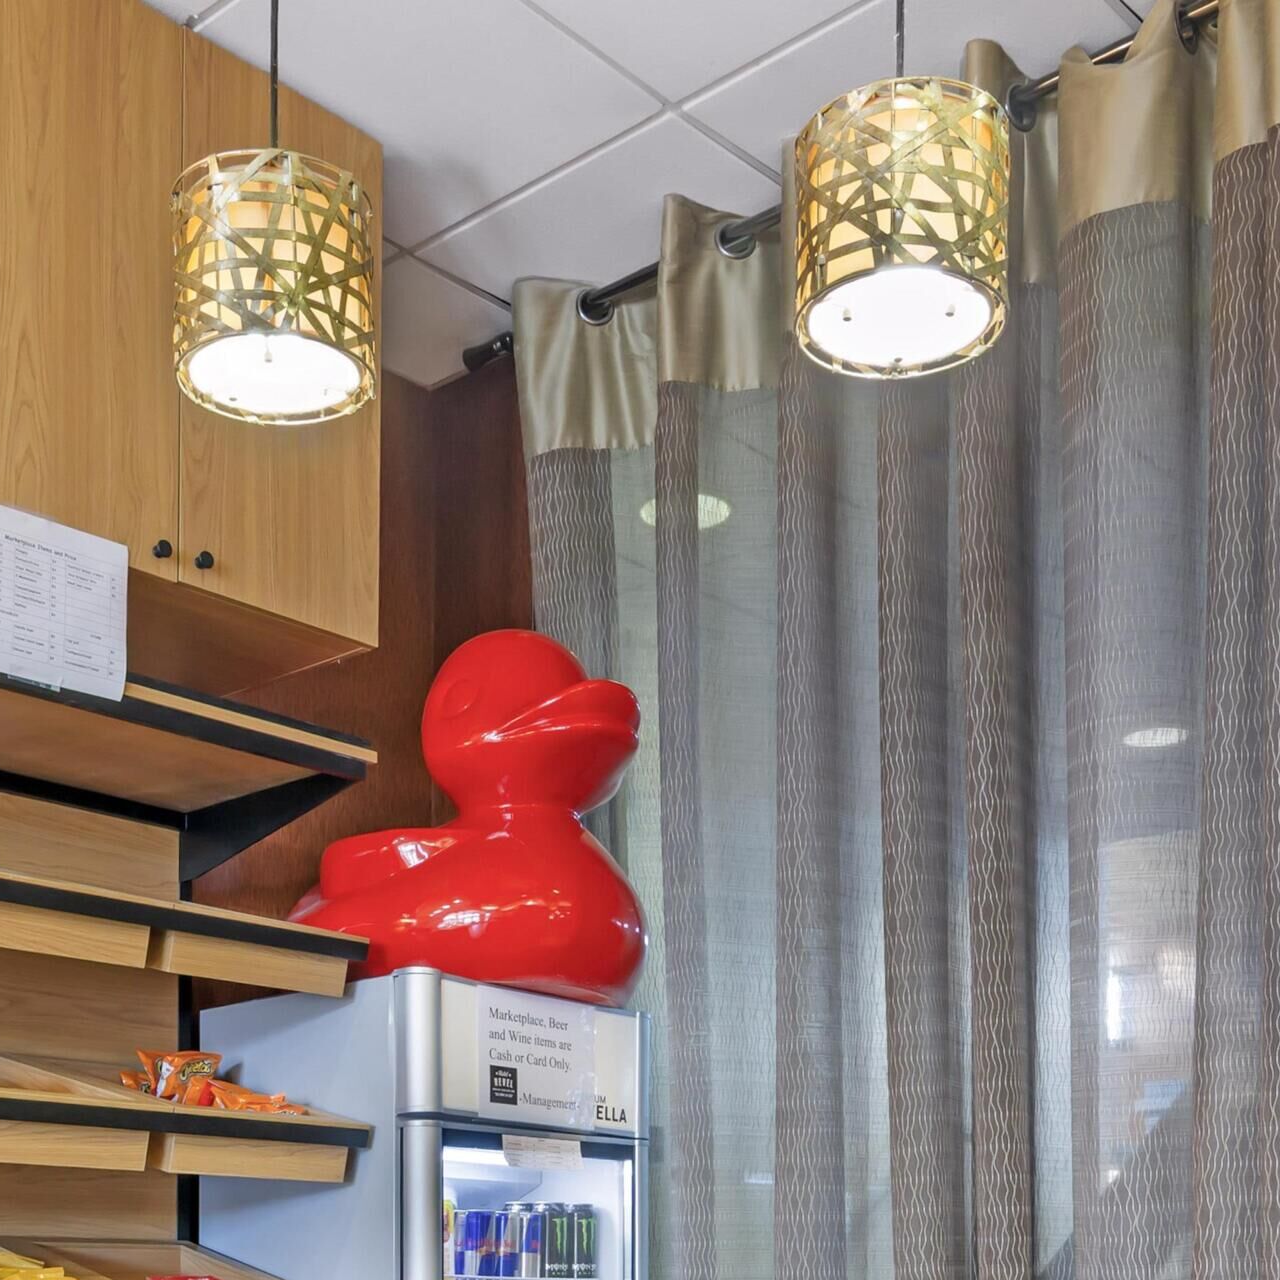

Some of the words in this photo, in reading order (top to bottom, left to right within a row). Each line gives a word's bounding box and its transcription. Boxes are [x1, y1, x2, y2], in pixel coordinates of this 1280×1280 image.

[489, 1007, 547, 1028] Marketplace,
[548, 1016, 569, 1031] Beer
[488, 1029, 506, 1041] and
[508, 1031, 532, 1045] Wine
[534, 1034, 557, 1049] items
[558, 1040, 572, 1051] are
[489, 1047, 513, 1062] Cash
[514, 1054, 524, 1064] or
[526, 1053, 547, 1067] Card
[549, 1058, 572, 1073] Only.
